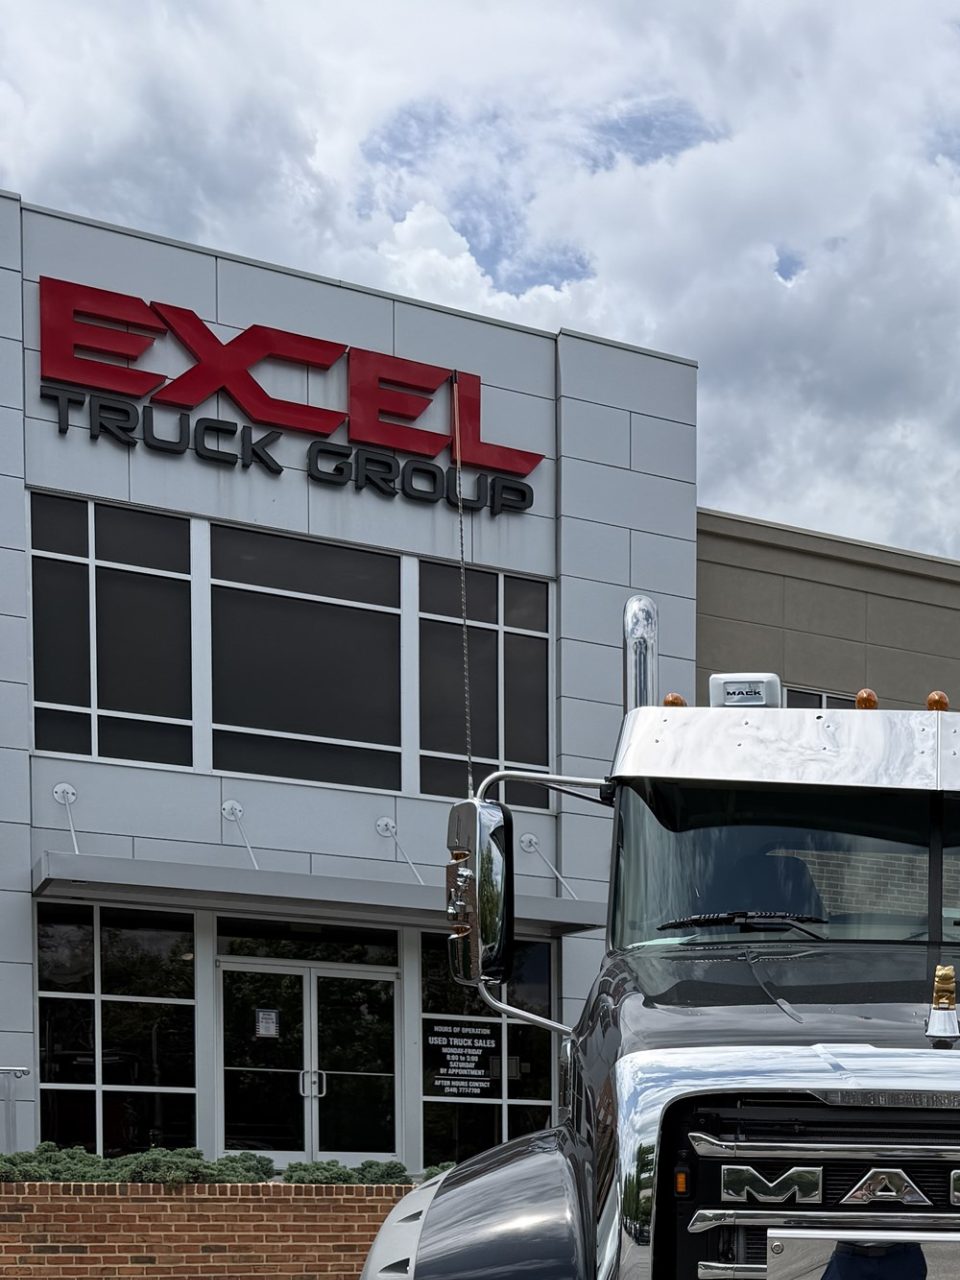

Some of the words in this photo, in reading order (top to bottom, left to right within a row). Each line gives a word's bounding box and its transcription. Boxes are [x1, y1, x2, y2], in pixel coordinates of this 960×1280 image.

[39, 275, 546, 477] EXCEL
[39, 385, 285, 475] TRUCK
[307, 439, 535, 516] GROUP
[474, 1039, 495, 1047] SALES
